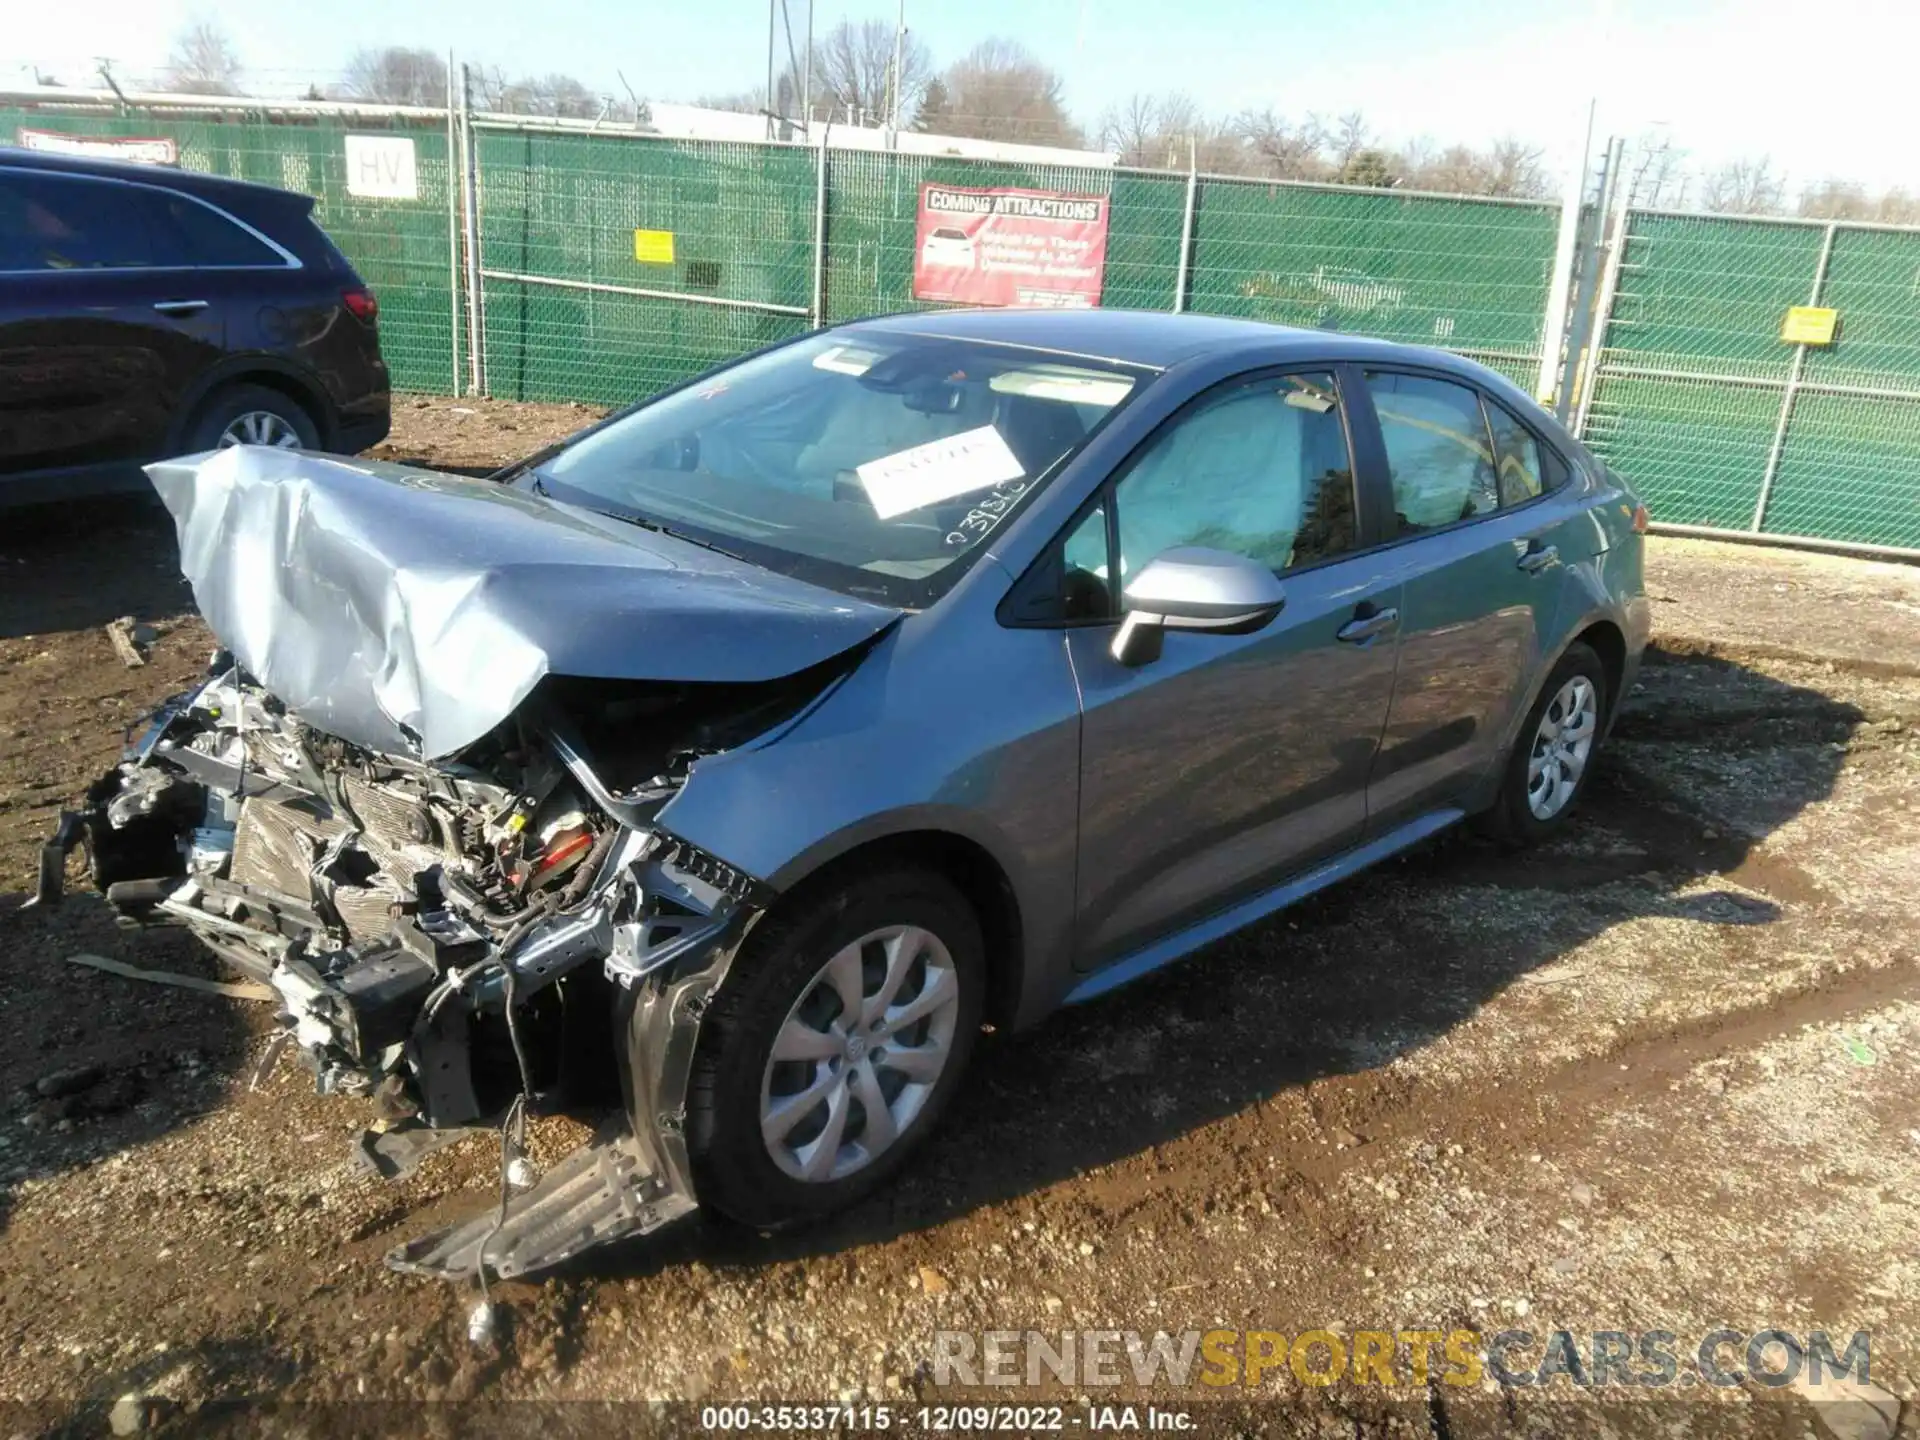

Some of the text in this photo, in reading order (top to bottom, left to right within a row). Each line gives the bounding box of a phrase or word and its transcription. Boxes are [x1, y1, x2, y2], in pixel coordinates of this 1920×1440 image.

[360, 150, 403, 184] HV
[930, 191, 1097, 219] COMING ATTRACTIONS
